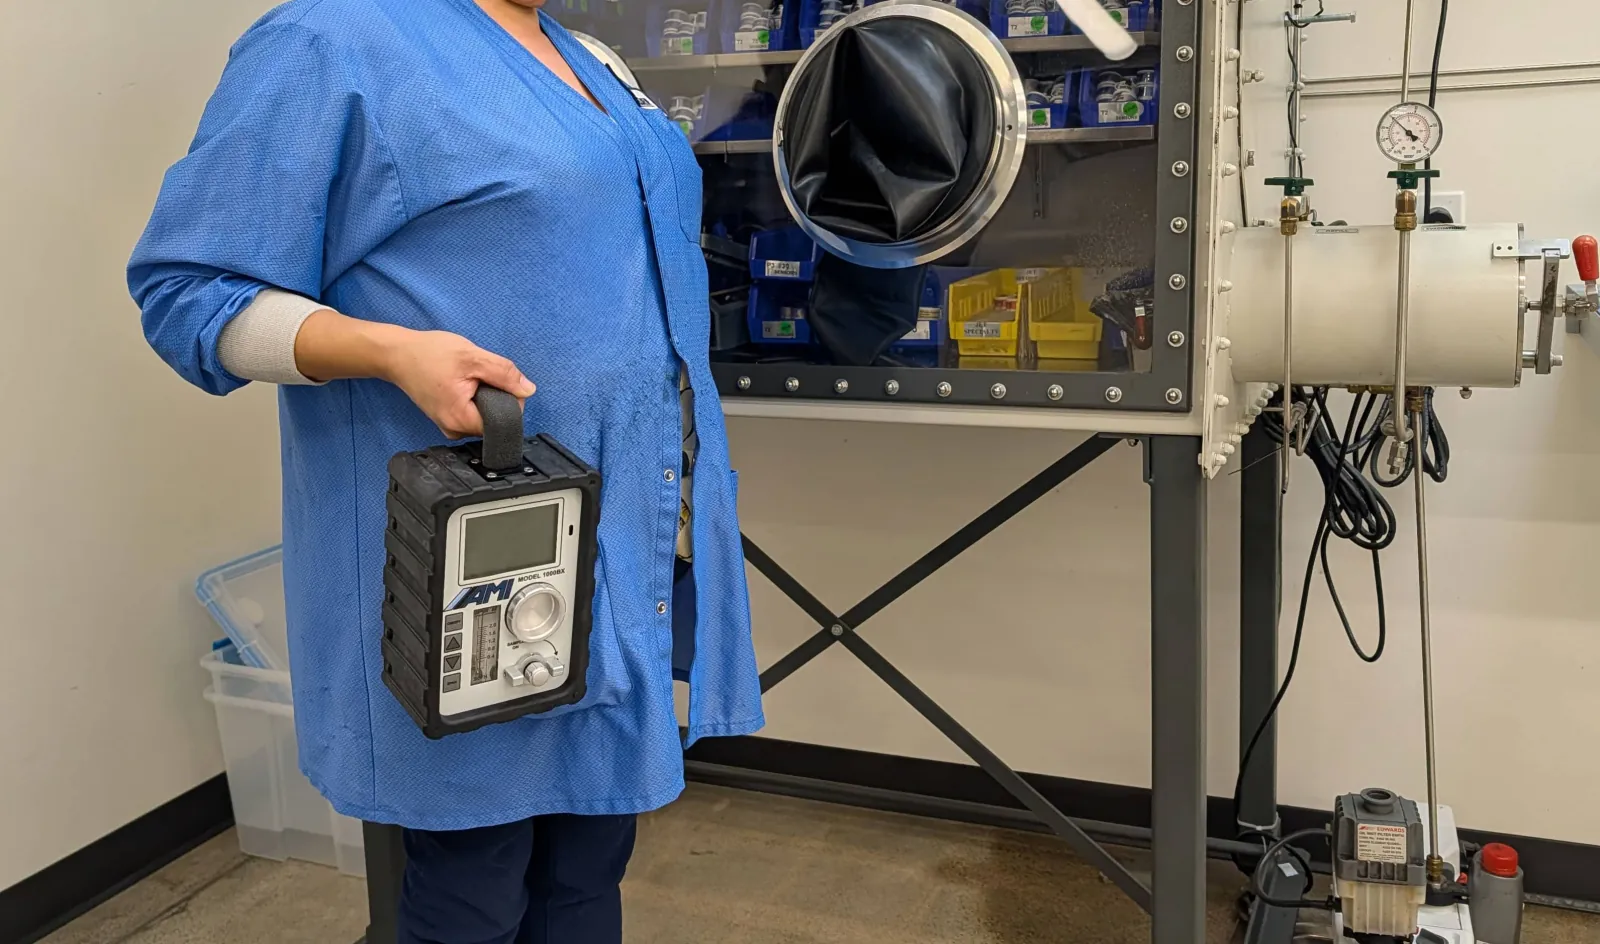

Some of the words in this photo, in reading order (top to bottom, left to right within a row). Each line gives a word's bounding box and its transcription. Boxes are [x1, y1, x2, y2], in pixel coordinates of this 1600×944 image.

[518, 573, 541, 583] MODEL
[543, 568, 565, 577] 1000BX
[452, 578, 515, 610] AMI
